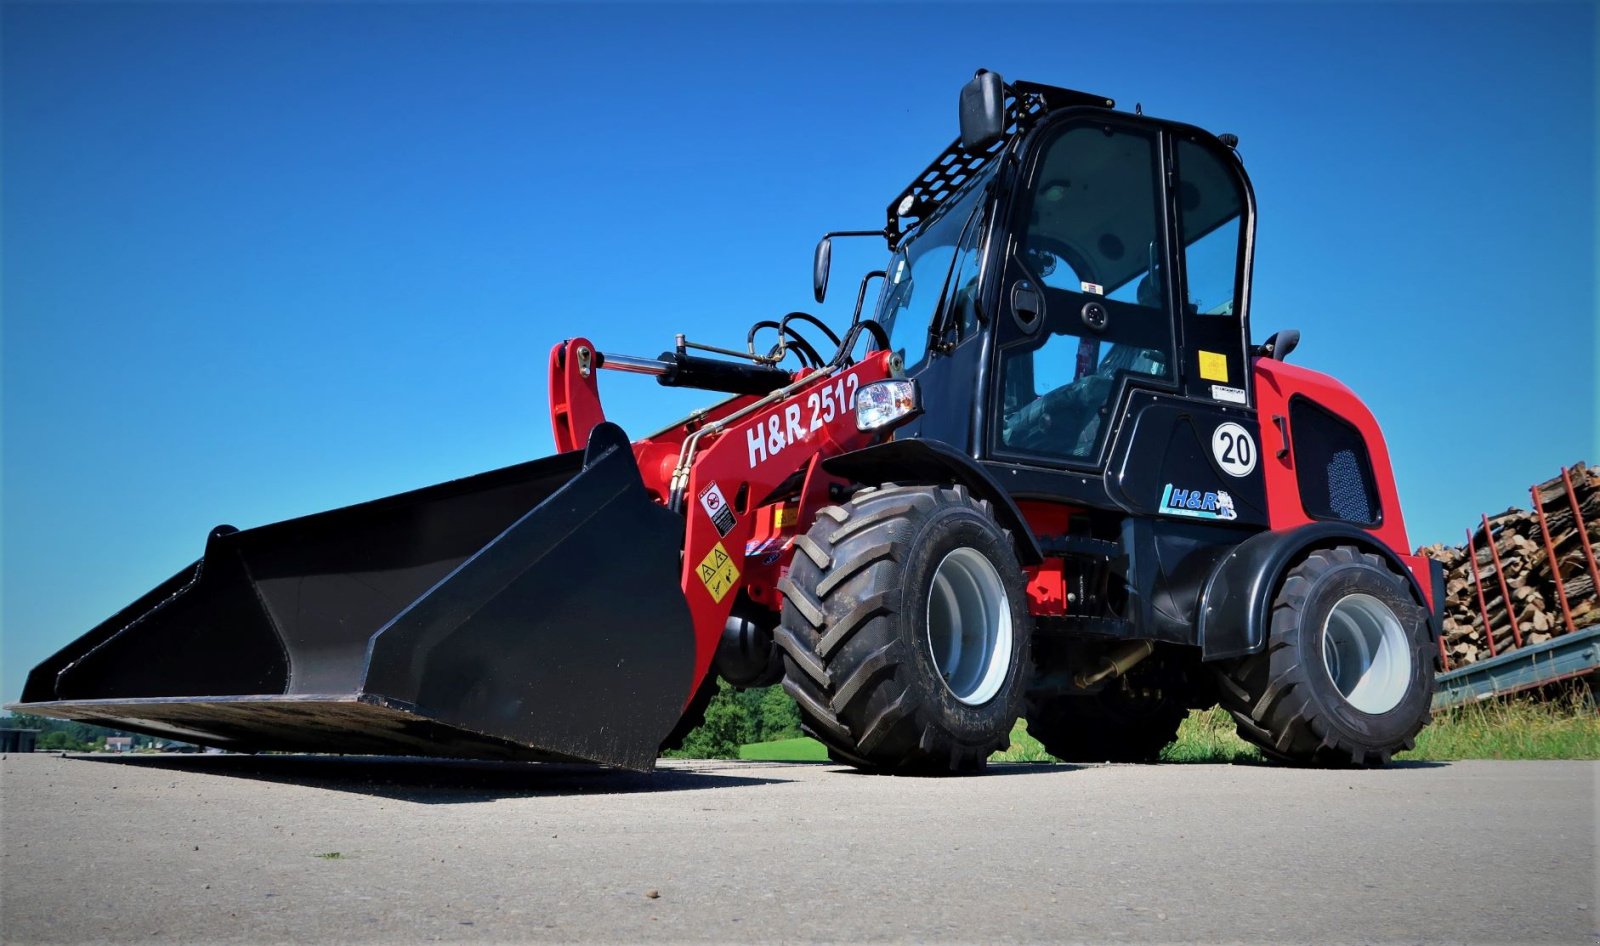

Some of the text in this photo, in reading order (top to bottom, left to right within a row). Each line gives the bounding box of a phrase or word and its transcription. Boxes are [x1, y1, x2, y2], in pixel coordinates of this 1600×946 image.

[746, 372, 859, 469] H&R 2512
[1220, 431, 1251, 467] 20
[1170, 488, 1218, 510] H&R
